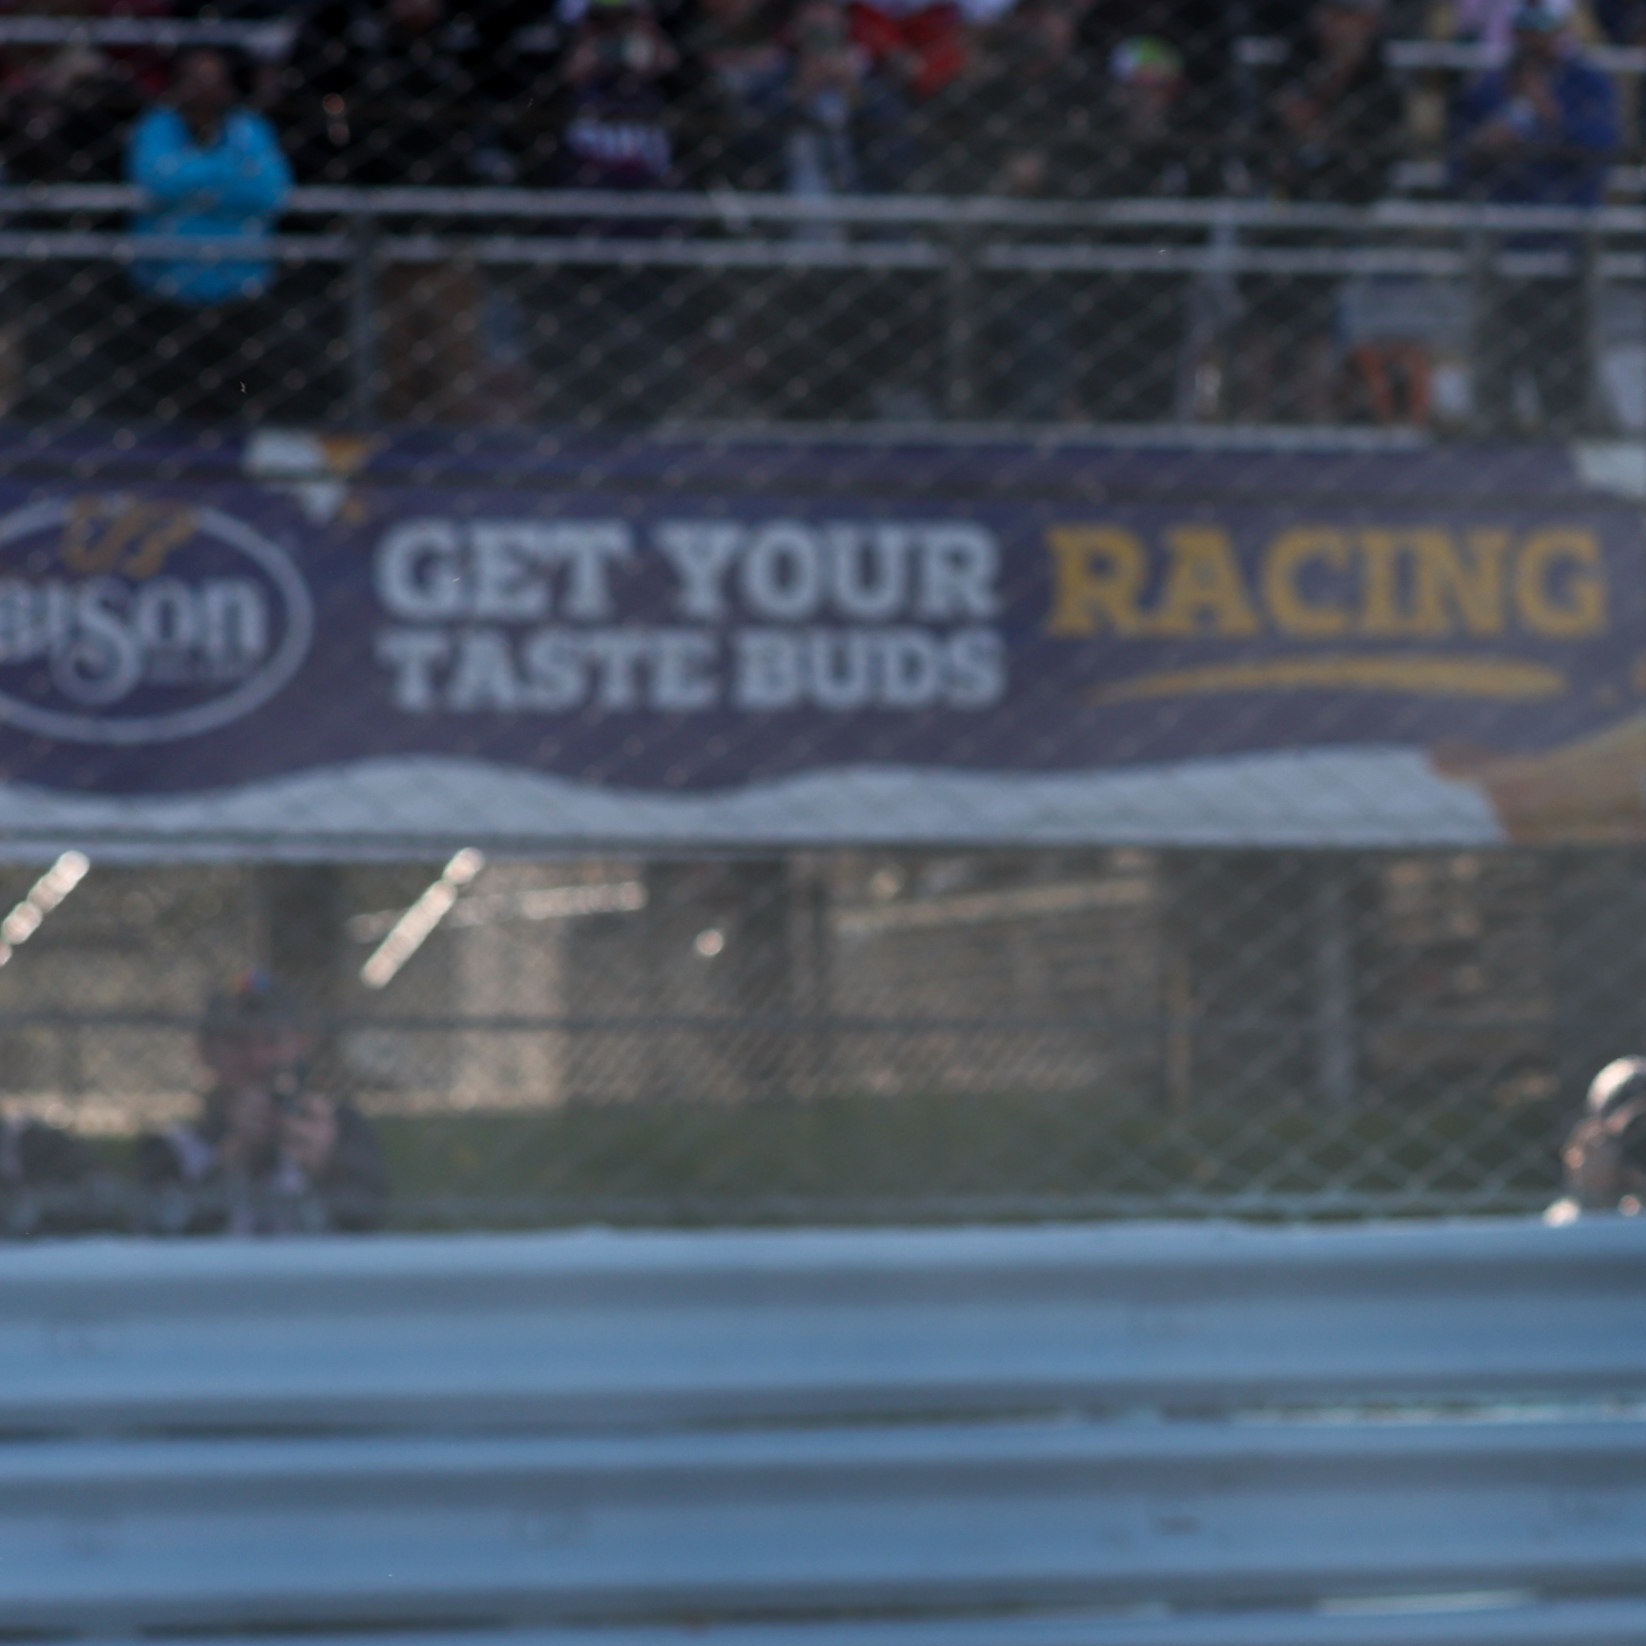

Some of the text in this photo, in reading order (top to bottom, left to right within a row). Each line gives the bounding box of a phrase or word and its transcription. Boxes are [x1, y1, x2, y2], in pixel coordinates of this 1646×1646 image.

[376, 518, 998, 620] GET YOUR
[1044, 521, 1606, 639] RACING
[376, 629, 1002, 711] TASTE BUDS
